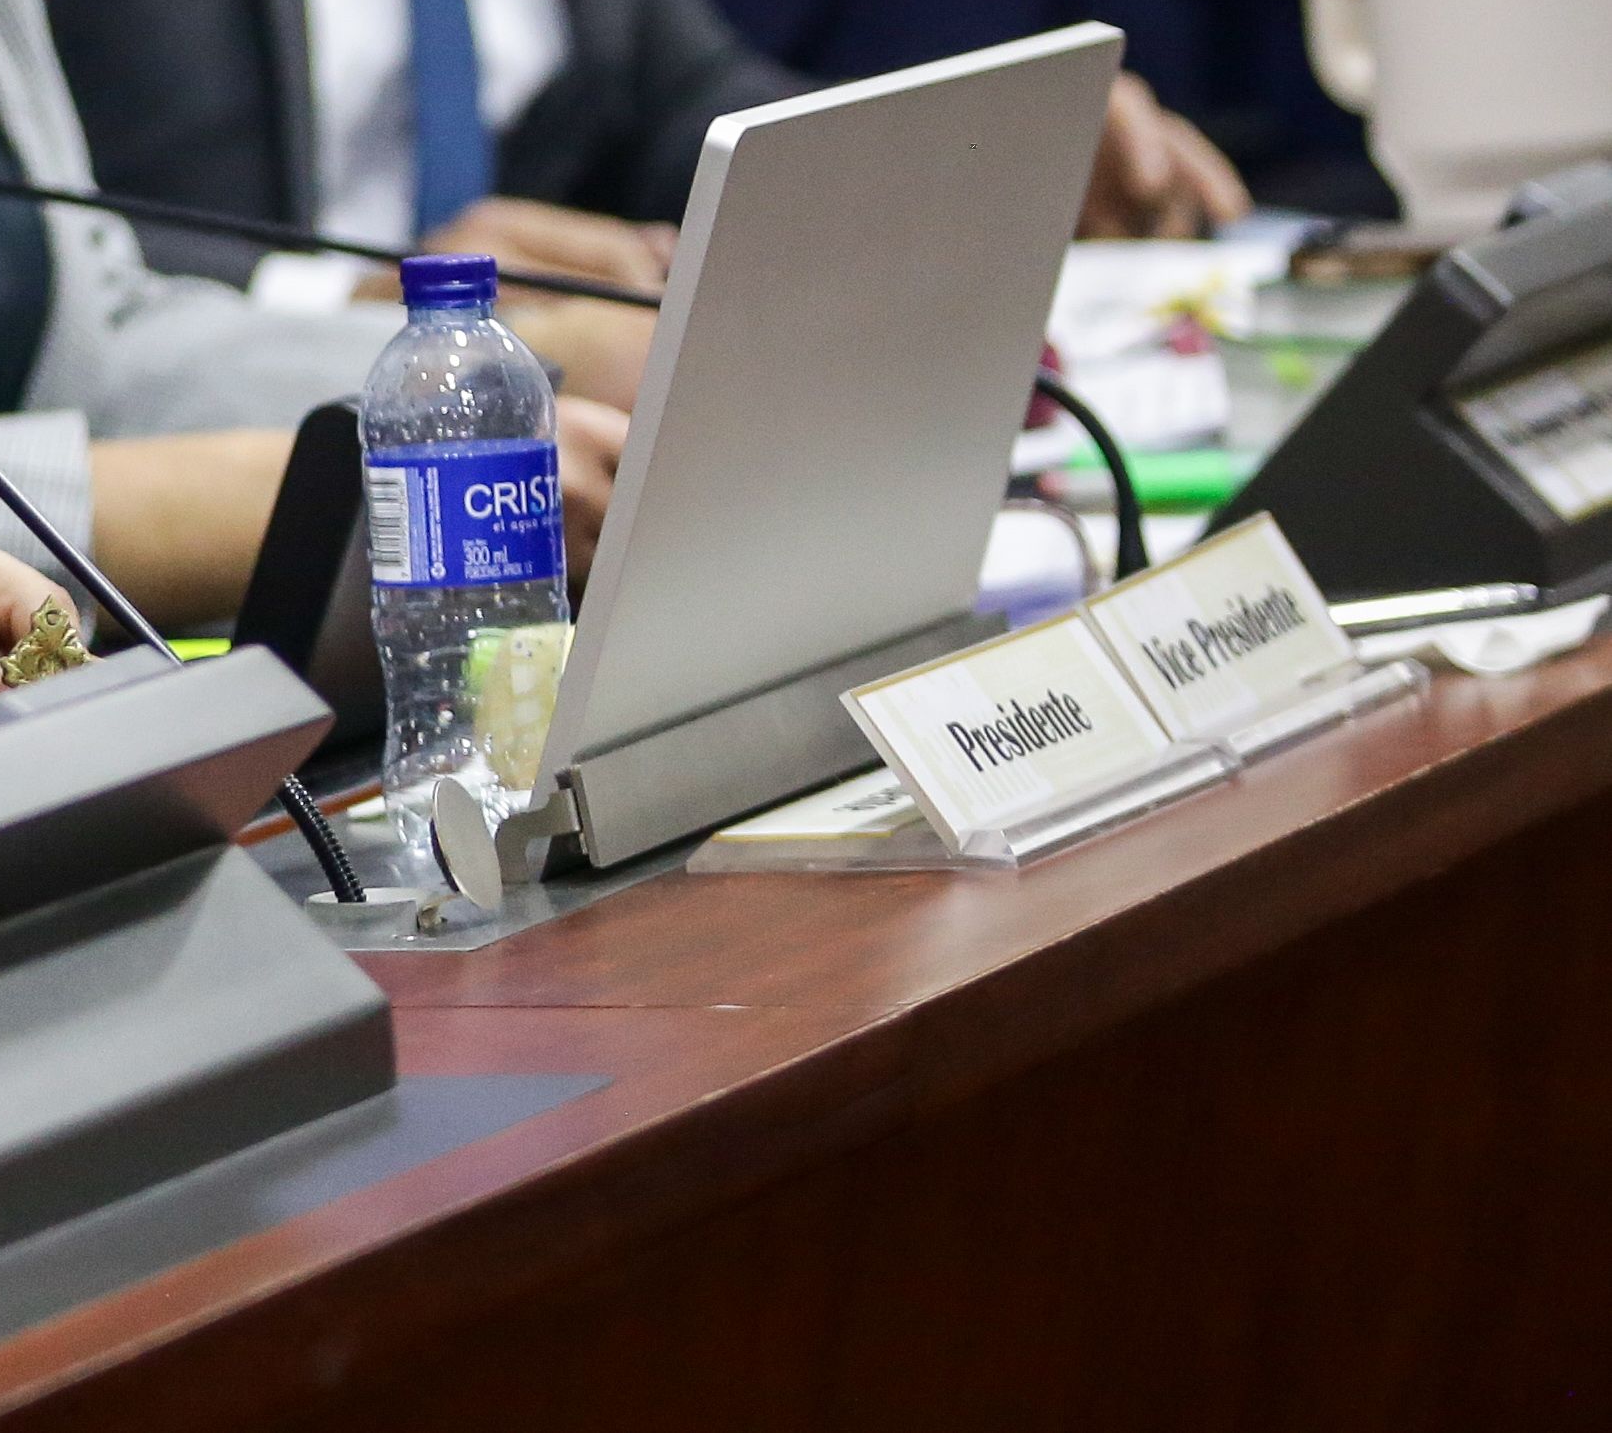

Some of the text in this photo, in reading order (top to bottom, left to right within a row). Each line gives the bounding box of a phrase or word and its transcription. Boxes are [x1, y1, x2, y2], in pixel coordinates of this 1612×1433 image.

[463, 545, 490, 566] 300
[1140, 584, 1307, 690] Vice Presidente
[945, 686, 1093, 773] Presidente
